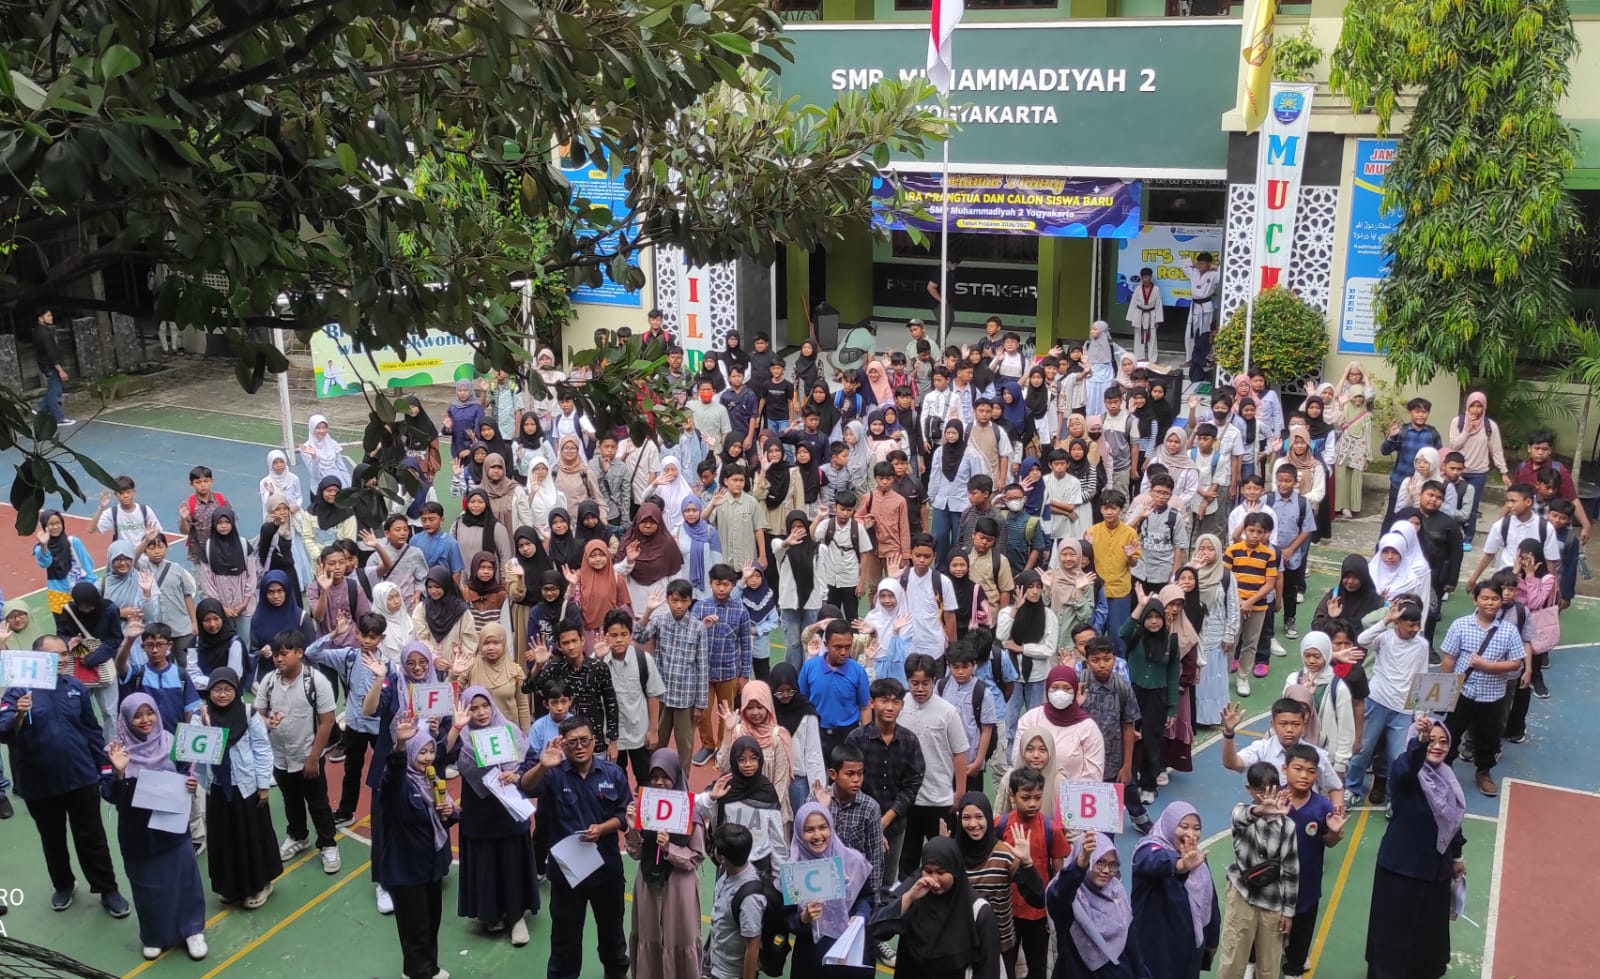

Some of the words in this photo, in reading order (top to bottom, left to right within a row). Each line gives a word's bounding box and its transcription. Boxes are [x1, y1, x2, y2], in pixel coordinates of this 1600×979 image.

[899, 68, 1127, 92] MAMMADIYAH
[1139, 68, 1157, 92] 2
[983, 193, 1005, 204] DAN
[1007, 194, 1043, 205] CALON
[1045, 195, 1080, 206] SISWA
[1082, 196, 1114, 207] BARU
[950, 206, 1016, 218] Muhammadiyah
[1016, 208, 1024, 217] 2
[1026, 208, 1075, 219] Yogyakarta
[1142, 248, 1174, 264] IT'S
[1178, 250, 1220, 266] TIE
[21, 659, 38, 679] H
[428, 691, 439, 709] F
[1424, 682, 1441, 702] A
[191, 734, 208, 754] G
[490, 736, 501, 756] E
[656, 799, 673, 820] D
[1080, 793, 1097, 819] B
[804, 869, 823, 893] C
